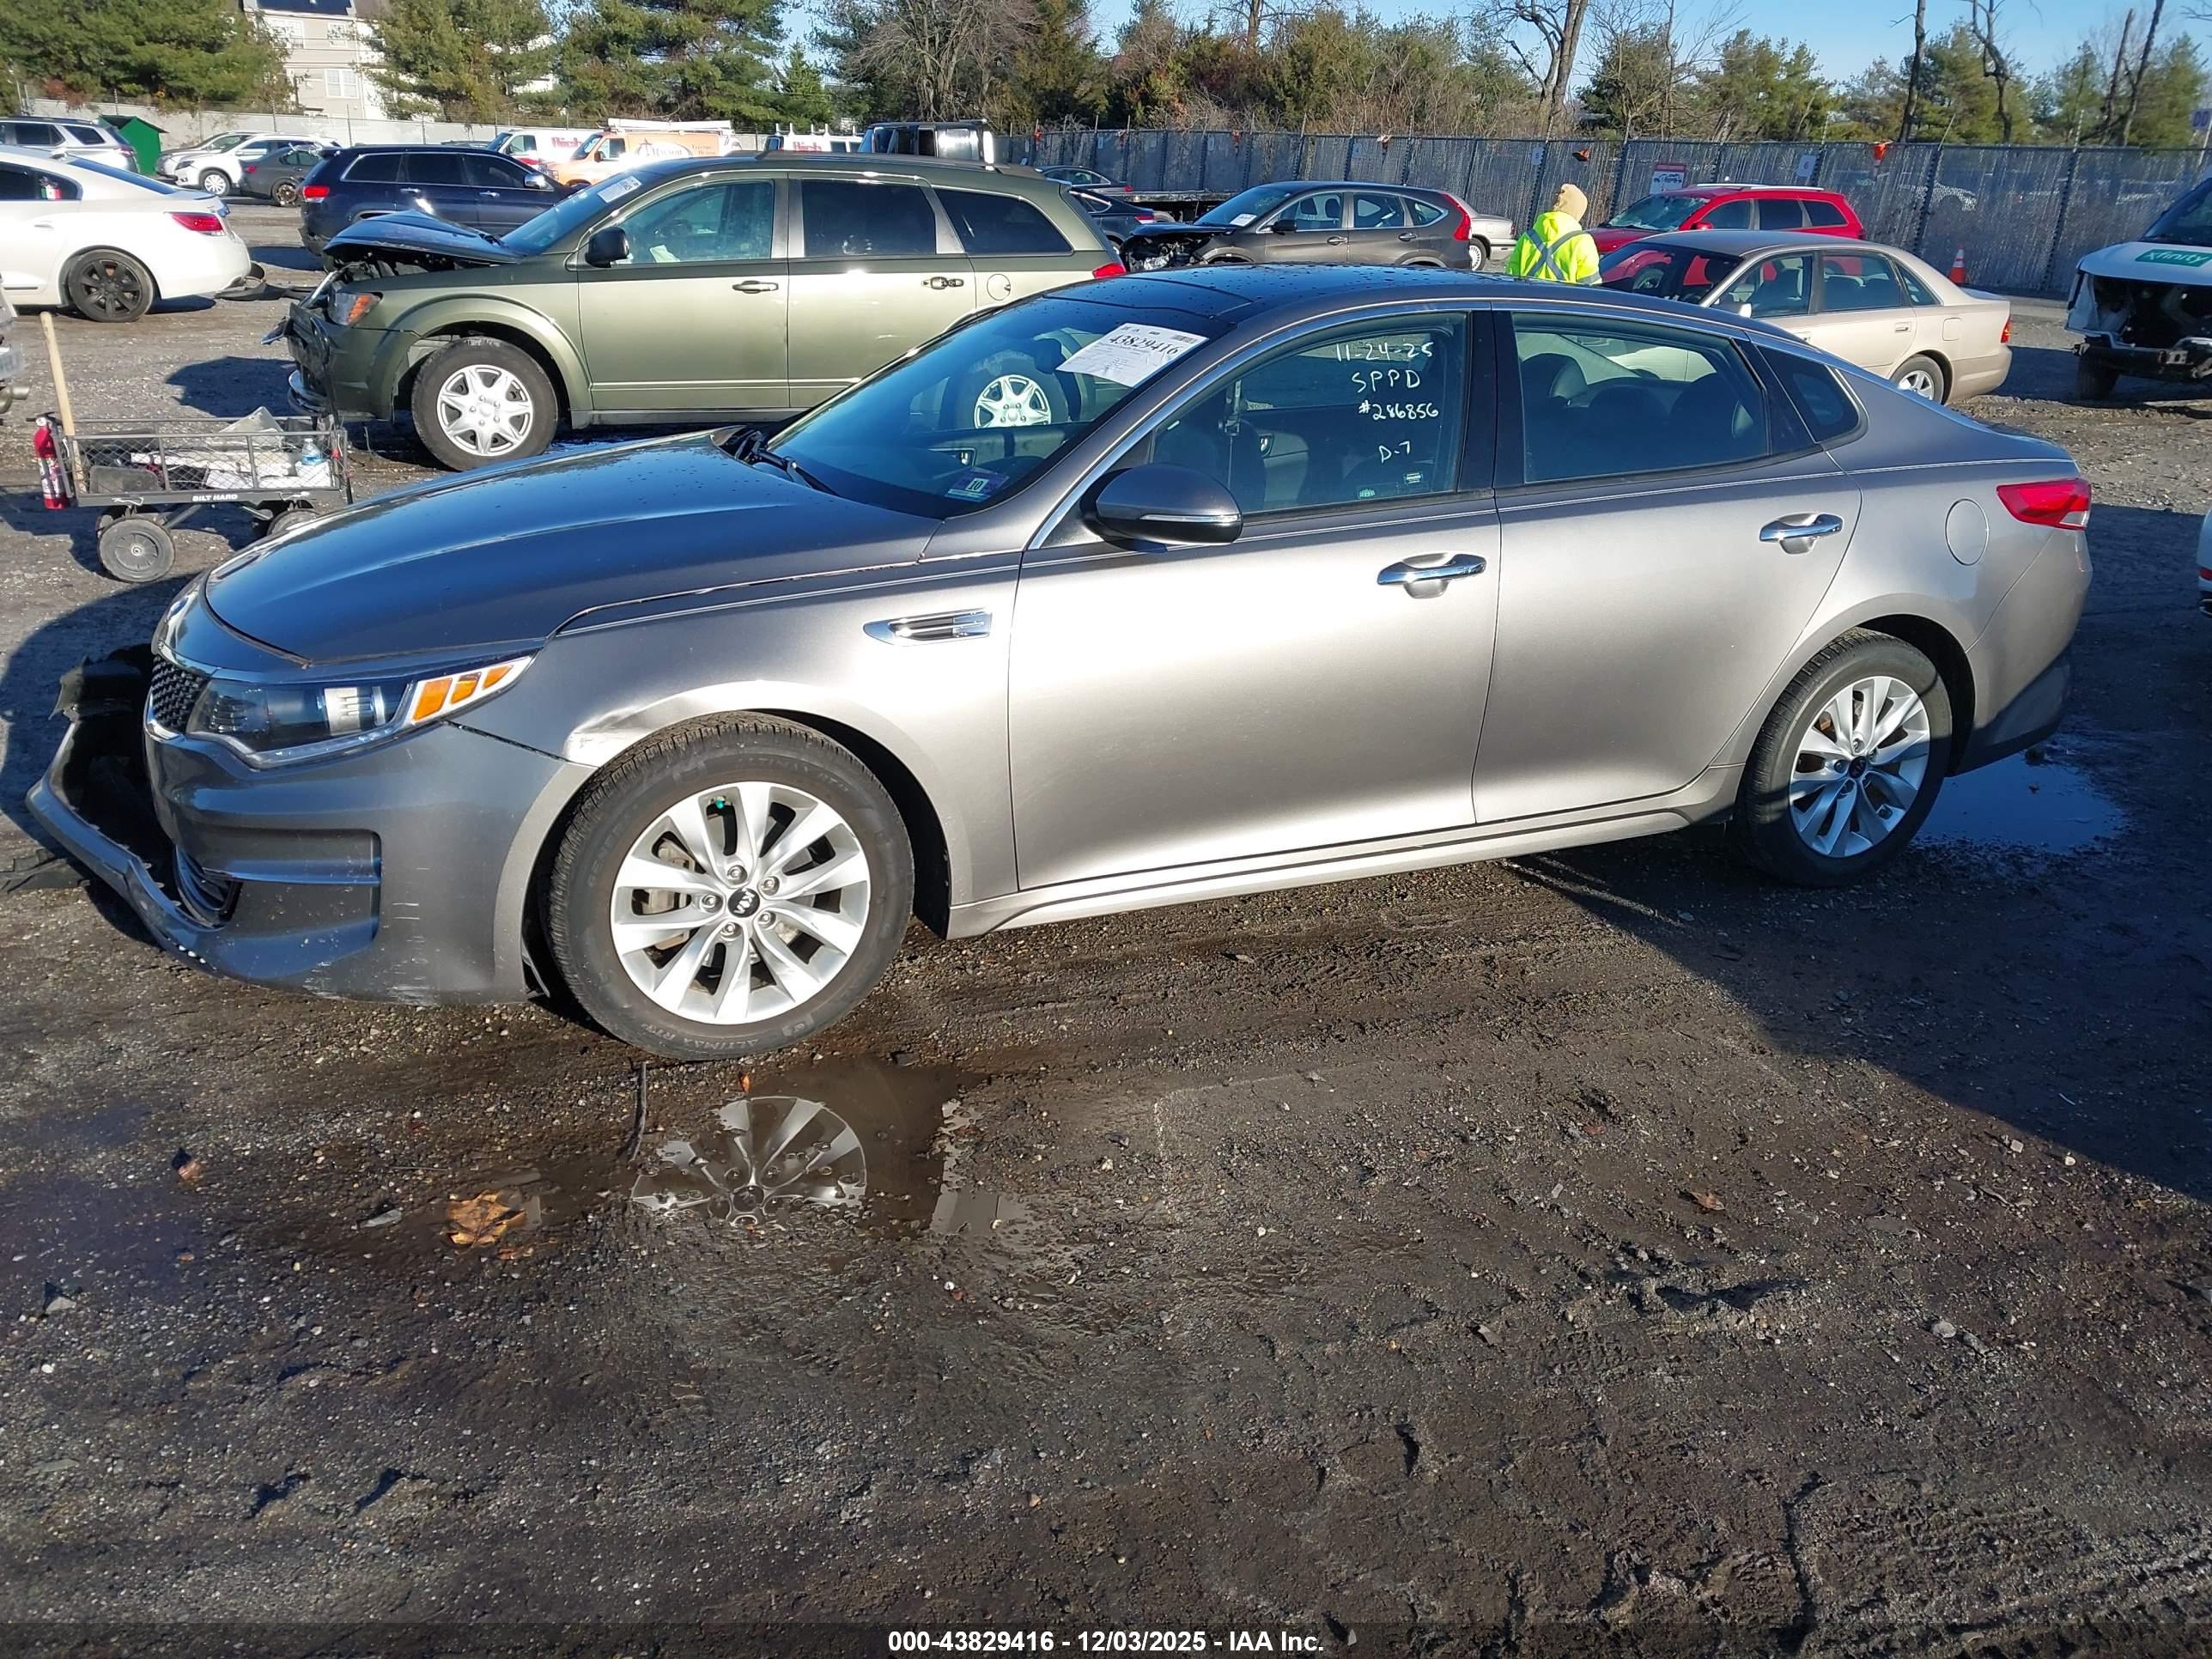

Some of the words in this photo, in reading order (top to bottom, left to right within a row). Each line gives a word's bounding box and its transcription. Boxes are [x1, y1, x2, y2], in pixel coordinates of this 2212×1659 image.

[2146, 250, 2209, 265] xfinity
[1108, 333, 1179, 355] 43829416
[1336, 341, 1435, 362] 11-24-25
[1351, 368, 1421, 393] SPPD
[1378, 441, 1411, 463] D-7
[968, 480, 984, 491] 10
[191, 494, 212, 502] BILT
